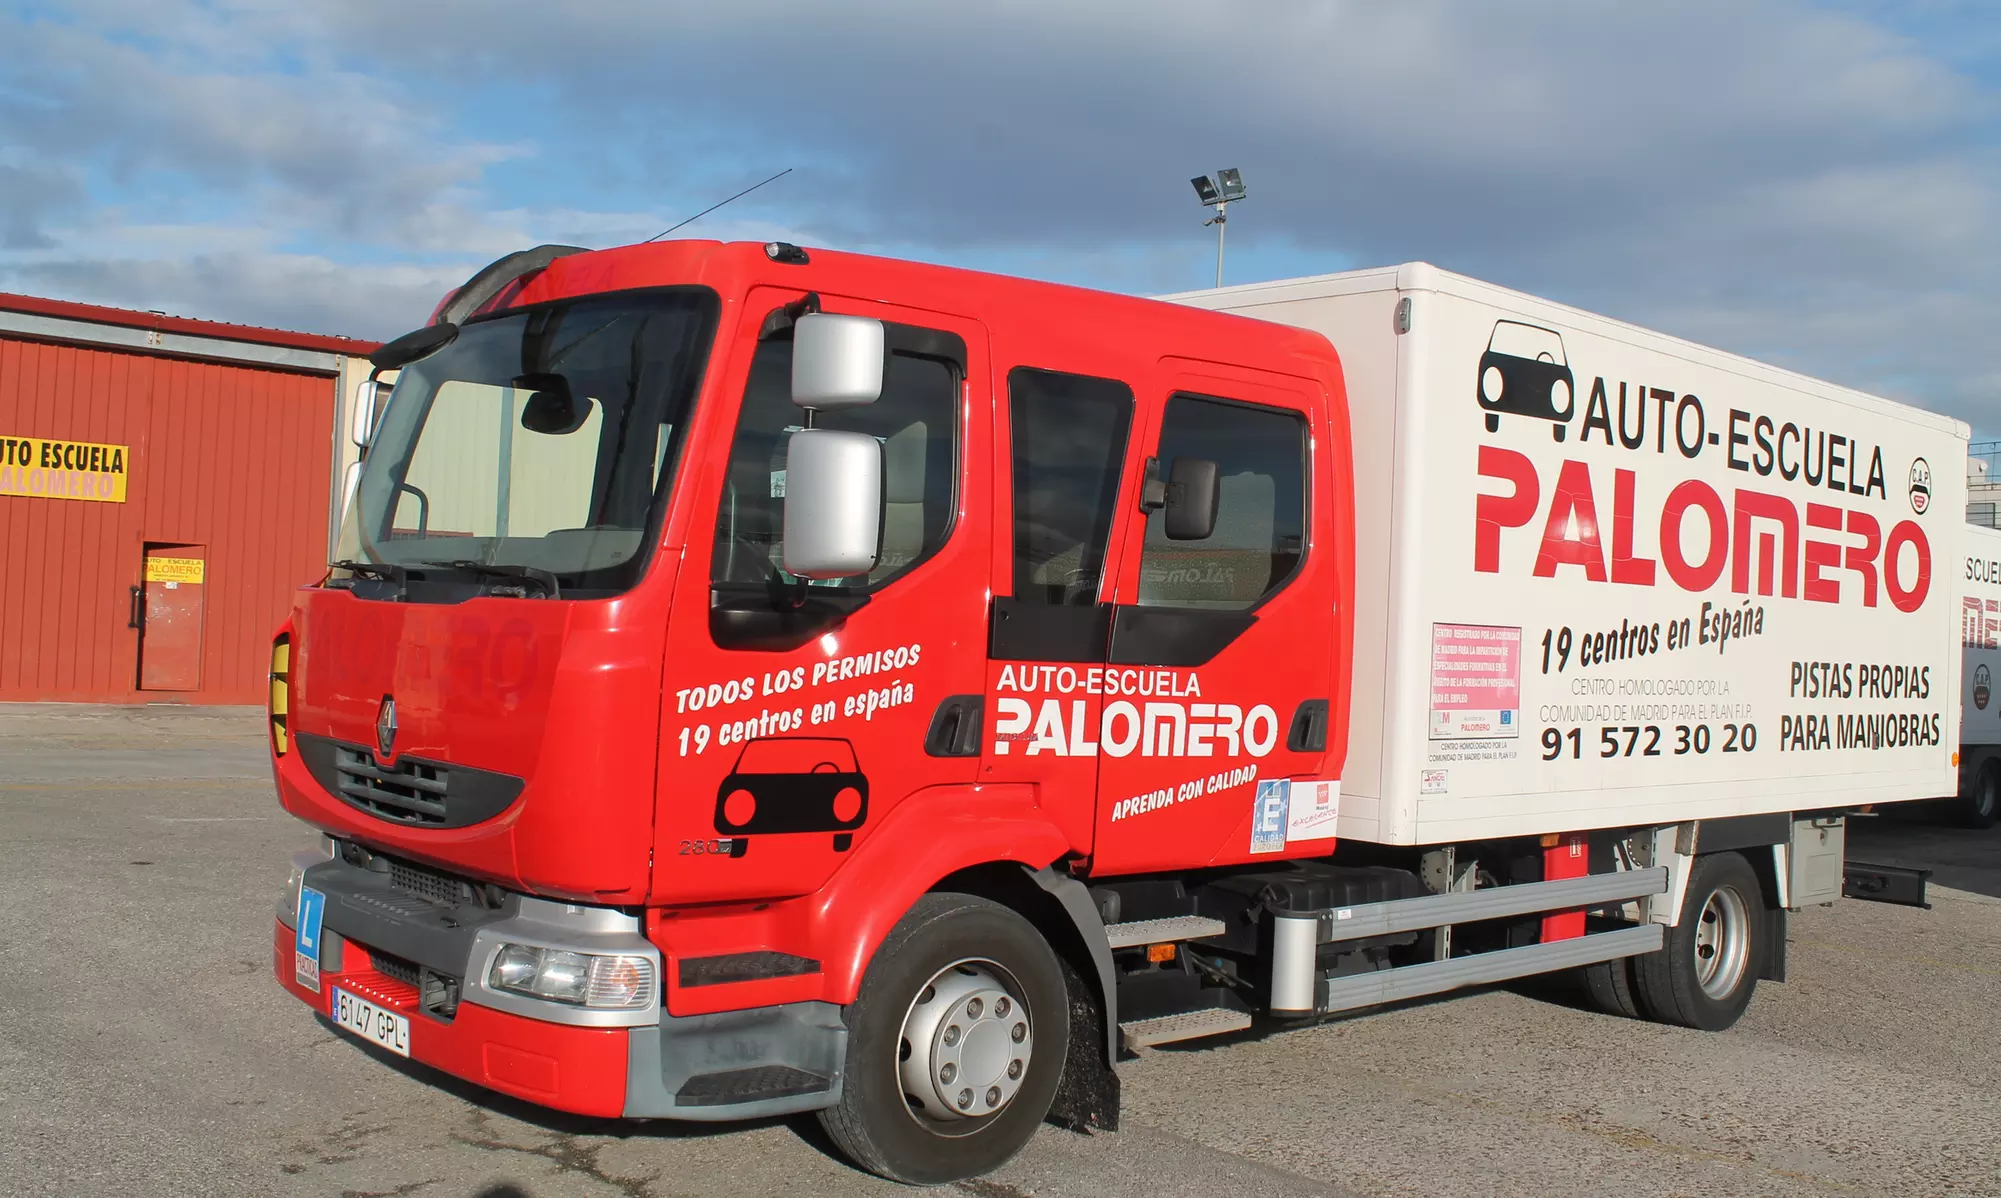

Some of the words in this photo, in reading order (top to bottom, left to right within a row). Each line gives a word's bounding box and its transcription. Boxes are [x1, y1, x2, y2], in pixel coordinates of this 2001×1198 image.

[40, 442, 124, 473] ESCUELA
[1580, 377, 1886, 499] AUTO-ESCUELA
[1474, 444, 1931, 613] PALOMERO
[1541, 626, 1572, 675] 19
[1581, 618, 1660, 667] centros
[1667, 618, 1690, 650] en
[1698, 599, 1764, 655] España
[676, 677, 755, 713] TODOS
[762, 666, 805, 696] LOS
[812, 644, 921, 686] PERMISOS
[996, 664, 1201, 698] AUTO-ESCUELA
[1572, 678, 1615, 696] CENTRO
[1618, 679, 1695, 696] HOMOLOGADO
[1697, 680, 1715, 696] POR
[1718, 680, 1729, 696] LA
[1790, 661, 1851, 699] PISTAS
[1858, 663, 1929, 700] PROPIAS
[678, 724, 711, 757] 19
[718, 707, 803, 744] centros
[811, 700, 836, 725] en
[844, 680, 914, 720] españa
[994, 697, 1278, 758] PALOMERO
[1539, 705, 1610, 722] COMUNIDAD
[1614, 705, 1627, 721] DE
[1631, 704, 1669, 721] MADRID
[1672, 704, 1696, 720] PARA
[1699, 704, 1708, 720] EL
[1711, 704, 1733, 720] PLAN
[1780, 713, 1831, 751] PARA
[1836, 712, 1940, 750] MANIOBRAS
[1541, 727, 1581, 761] 91
[1600, 725, 1661, 758] 572
[1674, 724, 1711, 755] 30
[1722, 723, 1757, 753] 20
[1112, 790, 1173, 822] APRENDA
[1178, 783, 1203, 803] CON
[1207, 764, 1258, 794] CALIDAD
[1254, 833, 1284, 843] CALIDAD
[302, 900, 312, 948] L
[341, 994, 371, 1032] 6147
[378, 1012, 403, 1049] GPL
